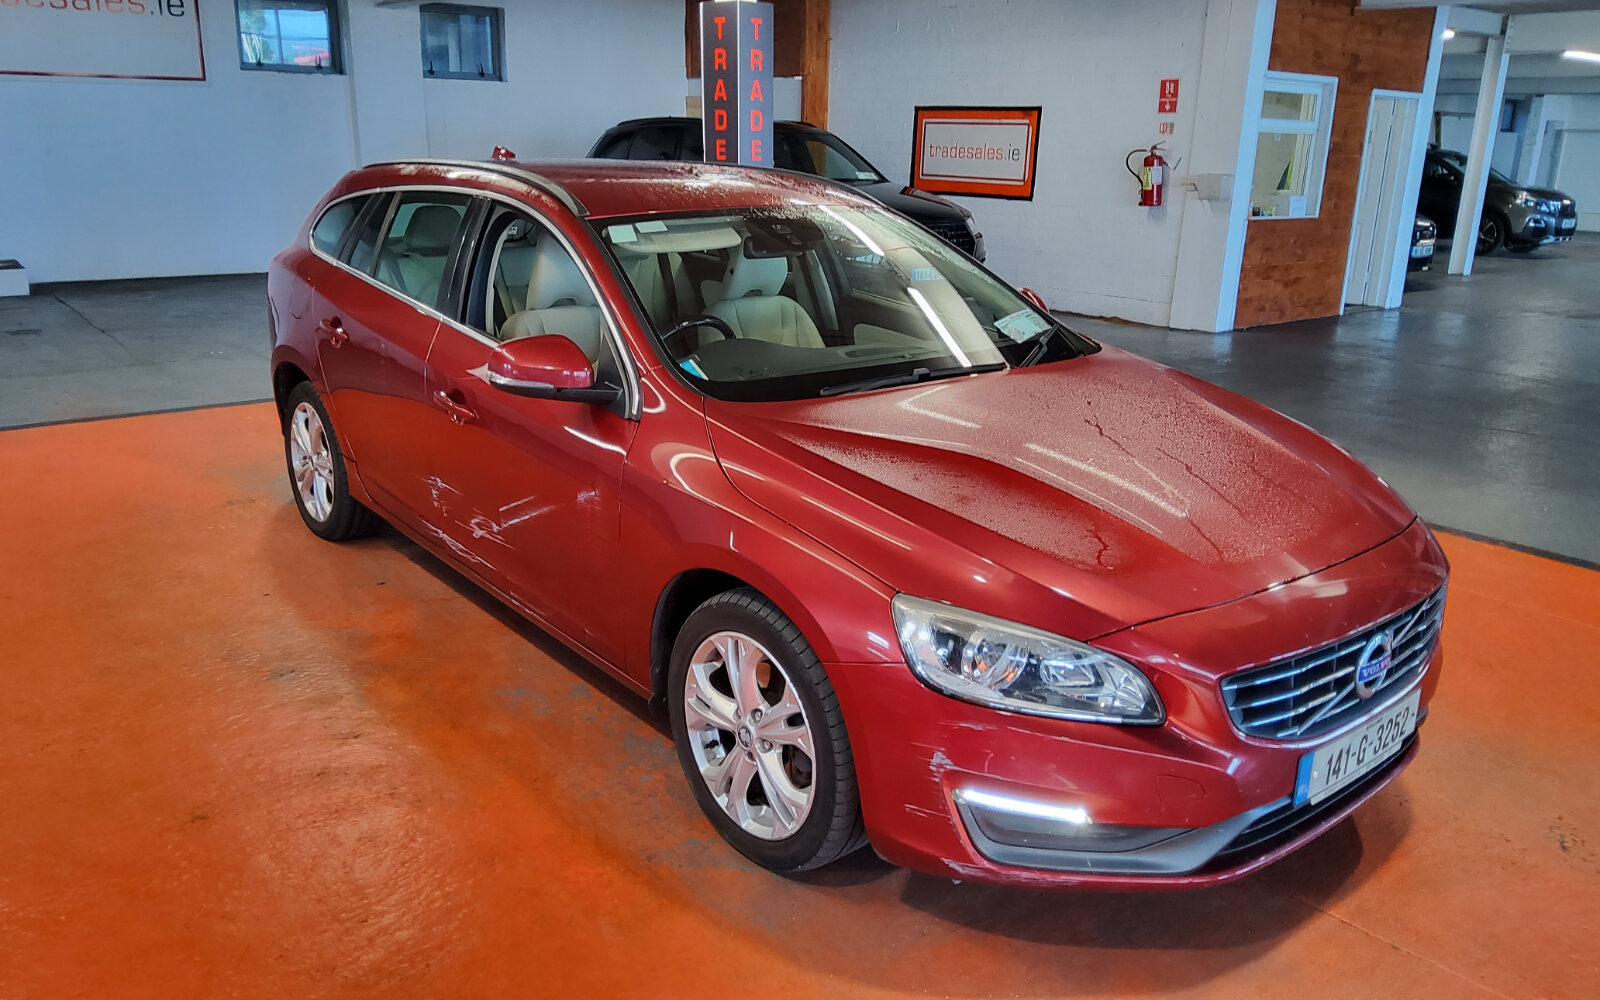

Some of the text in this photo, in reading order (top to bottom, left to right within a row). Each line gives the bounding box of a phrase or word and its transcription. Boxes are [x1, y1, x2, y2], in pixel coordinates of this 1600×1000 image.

[714, 16, 727, 161] TRADE
[751, 17, 763, 161] TRADE
[929, 142, 1020, 161] tradesales.ie
[1326, 706, 1409, 785] 141-G-3252
